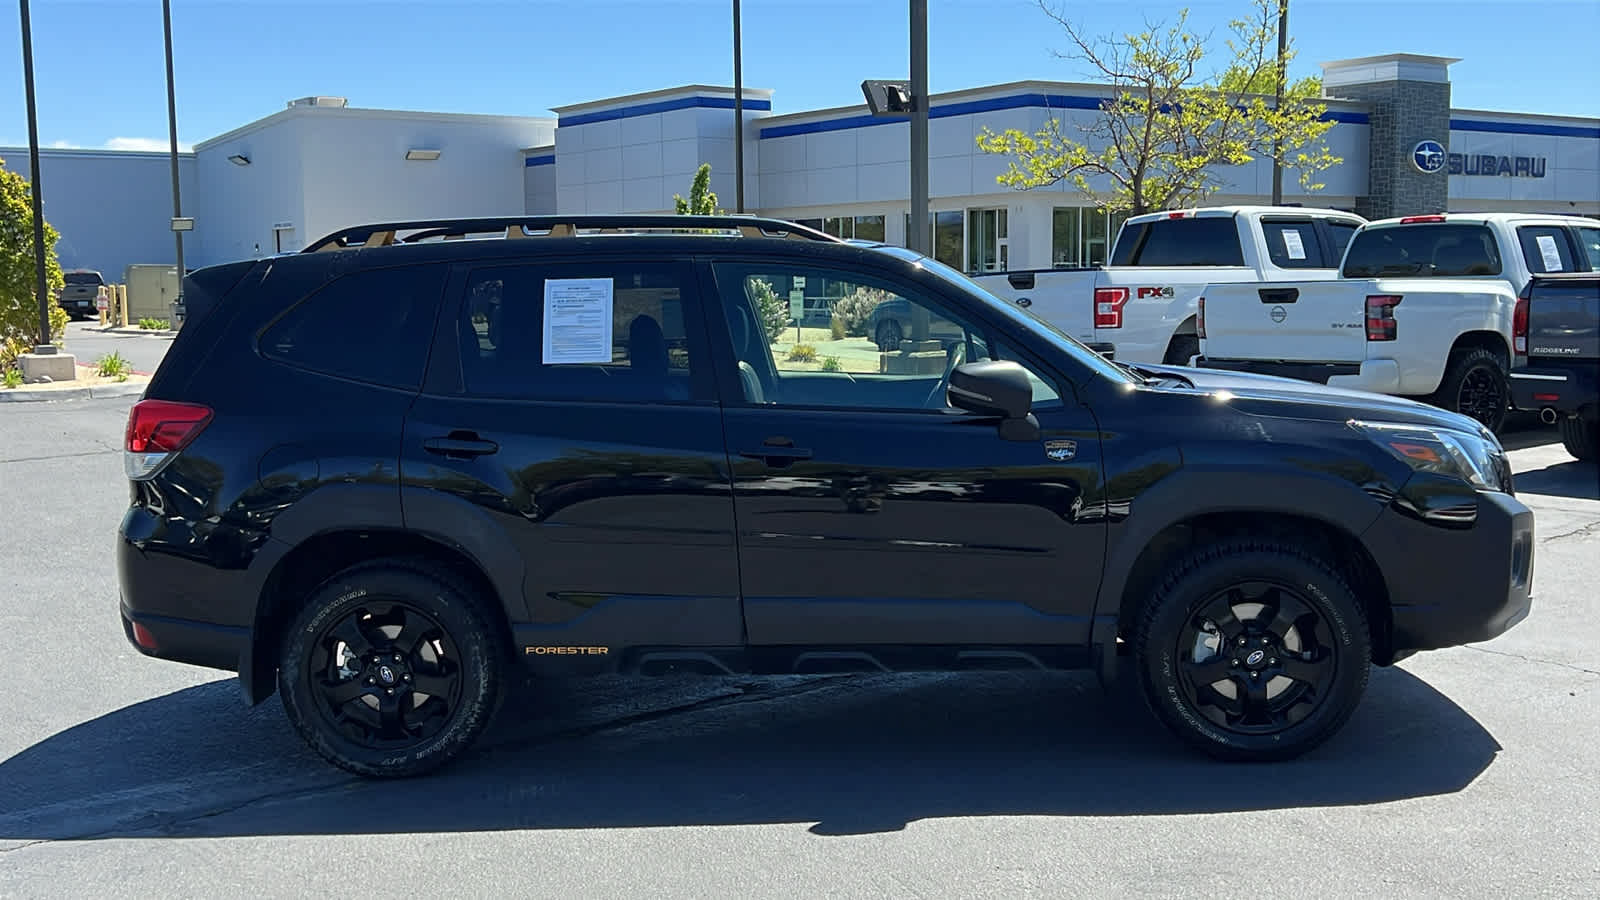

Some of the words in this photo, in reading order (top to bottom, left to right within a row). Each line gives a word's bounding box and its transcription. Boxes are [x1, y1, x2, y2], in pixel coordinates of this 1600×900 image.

[1449, 152, 1547, 178] SUBARU
[1137, 287, 1175, 300] FX4
[525, 646, 609, 655] FORESTER
